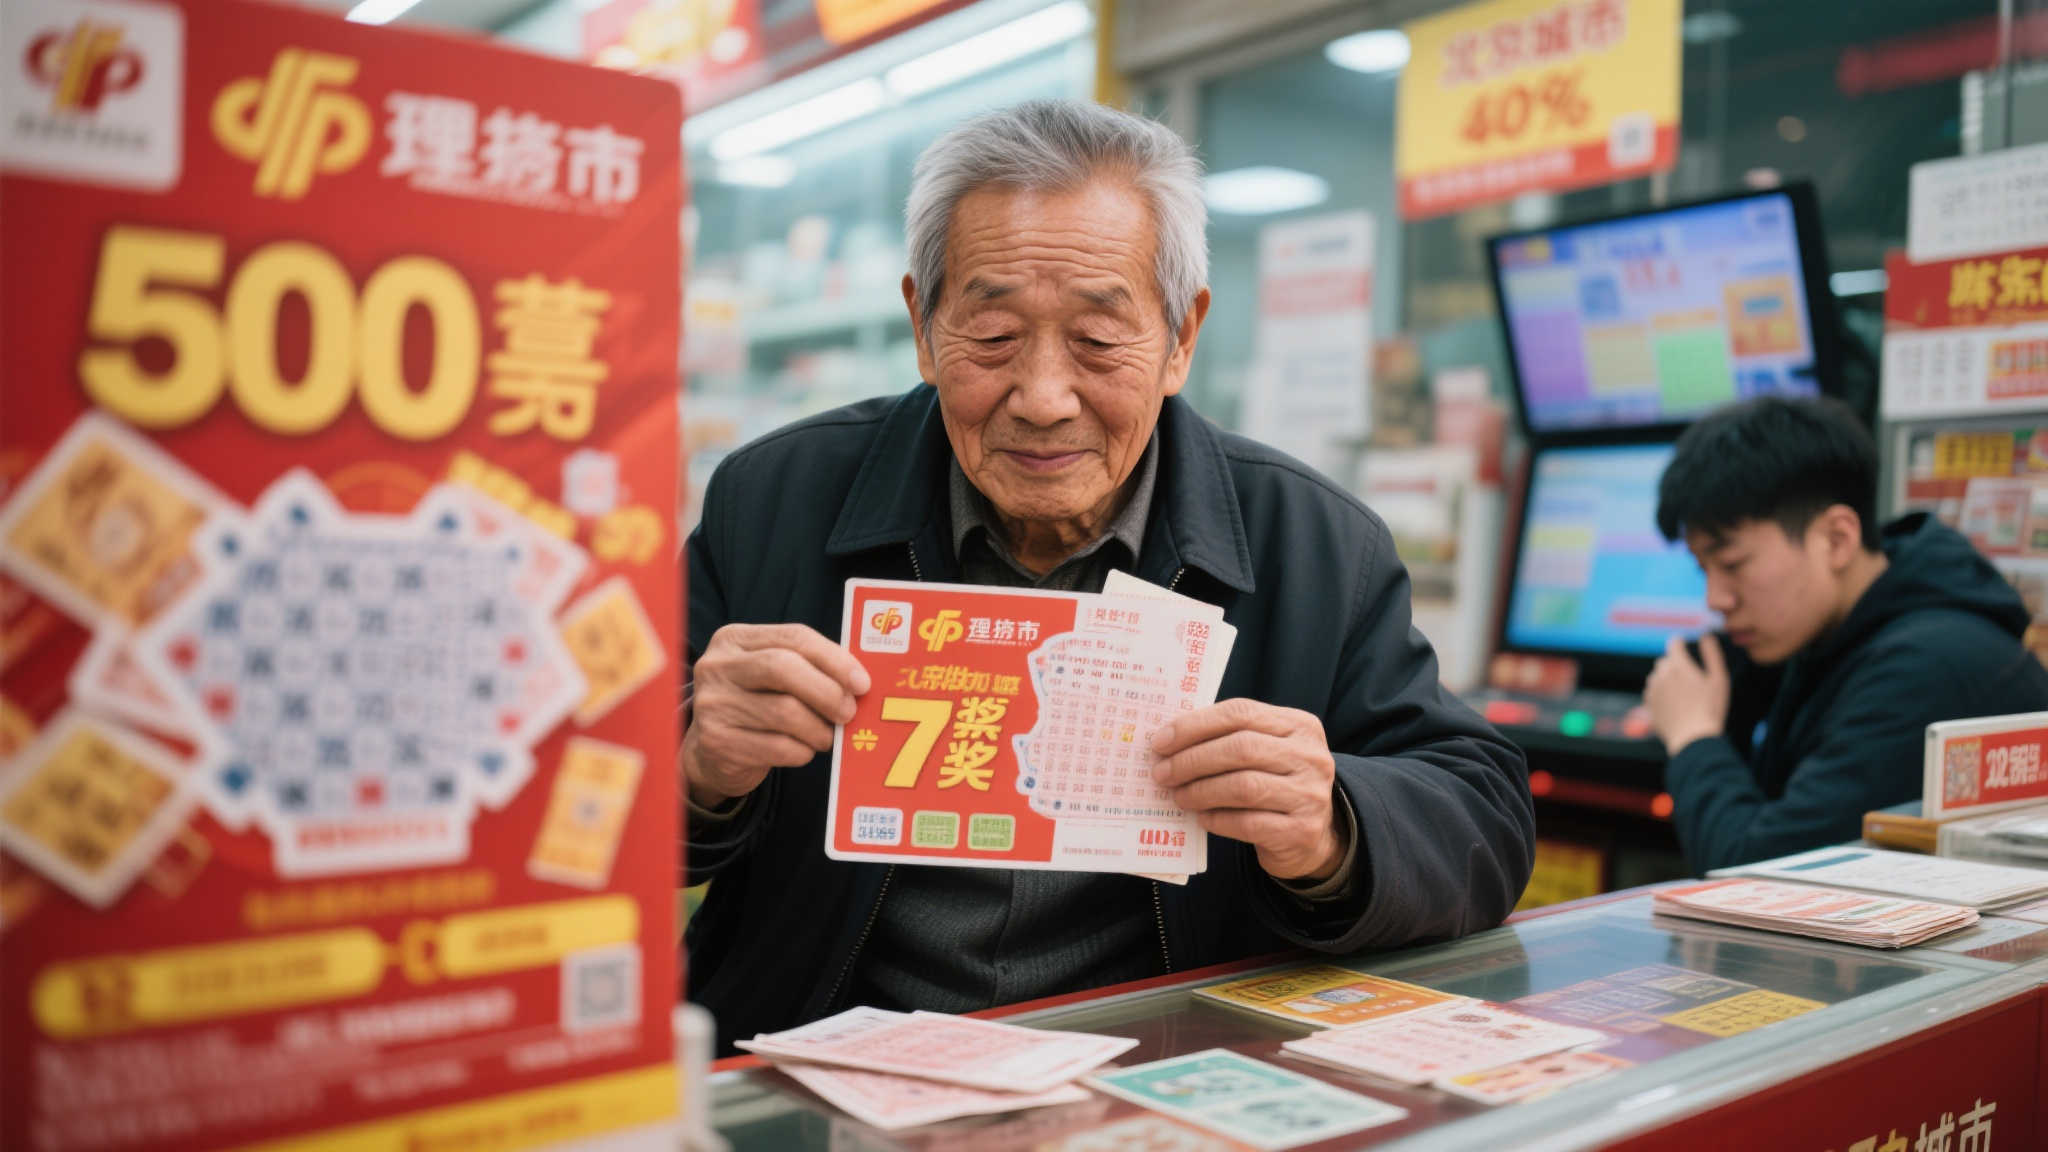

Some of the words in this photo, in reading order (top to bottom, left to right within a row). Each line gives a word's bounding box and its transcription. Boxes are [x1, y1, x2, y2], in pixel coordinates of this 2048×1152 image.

[1460, 66, 1593, 144] 40%
[79, 224, 482, 441] 500
[881, 697, 953, 788] 7
